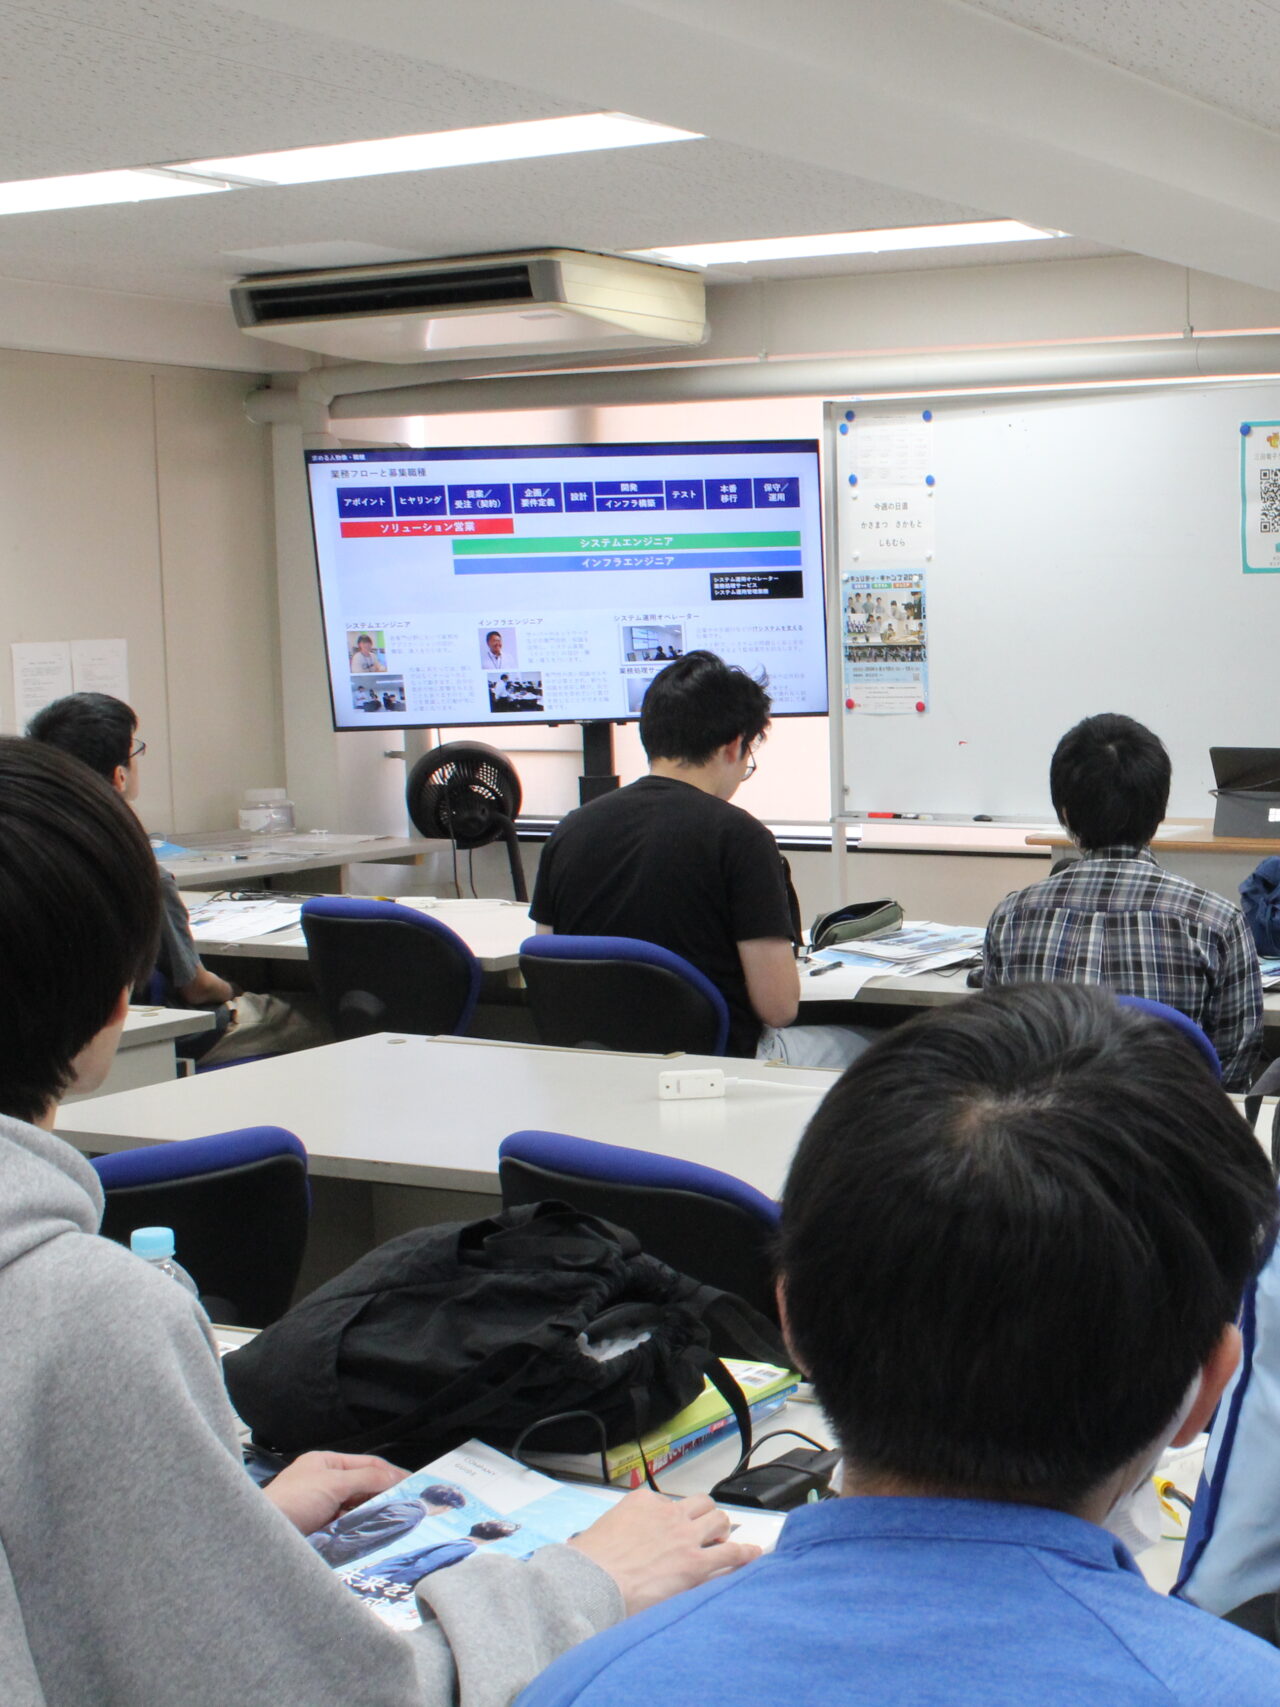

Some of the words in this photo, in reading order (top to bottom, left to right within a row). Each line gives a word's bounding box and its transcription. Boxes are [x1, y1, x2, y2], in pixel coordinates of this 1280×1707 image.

[331, 468, 427, 478] 業務フローと募集職種
[620, 483, 638, 492] 開発
[720, 484, 737, 493] 本番
[570, 492, 588, 501] 設計
[671, 490, 697, 499] テスト
[720, 494, 738, 503] 移行
[768, 493, 786, 502] 運用
[343, 497, 386, 506] アポイント
[399, 496, 442, 505] ヒヤリング
[521, 498, 556, 508] 要件定義
[605, 499, 656, 508] インフラ構築
[380, 521, 476, 533] ソリューション営業
[580, 537, 674, 548] システムエンジニア
[879, 538, 906, 548] しもむら
[582, 556, 674, 568] インフラエンジニア
[345, 621, 411, 629] システムエンジニア
[478, 618, 543, 626] インフラエンジニア
